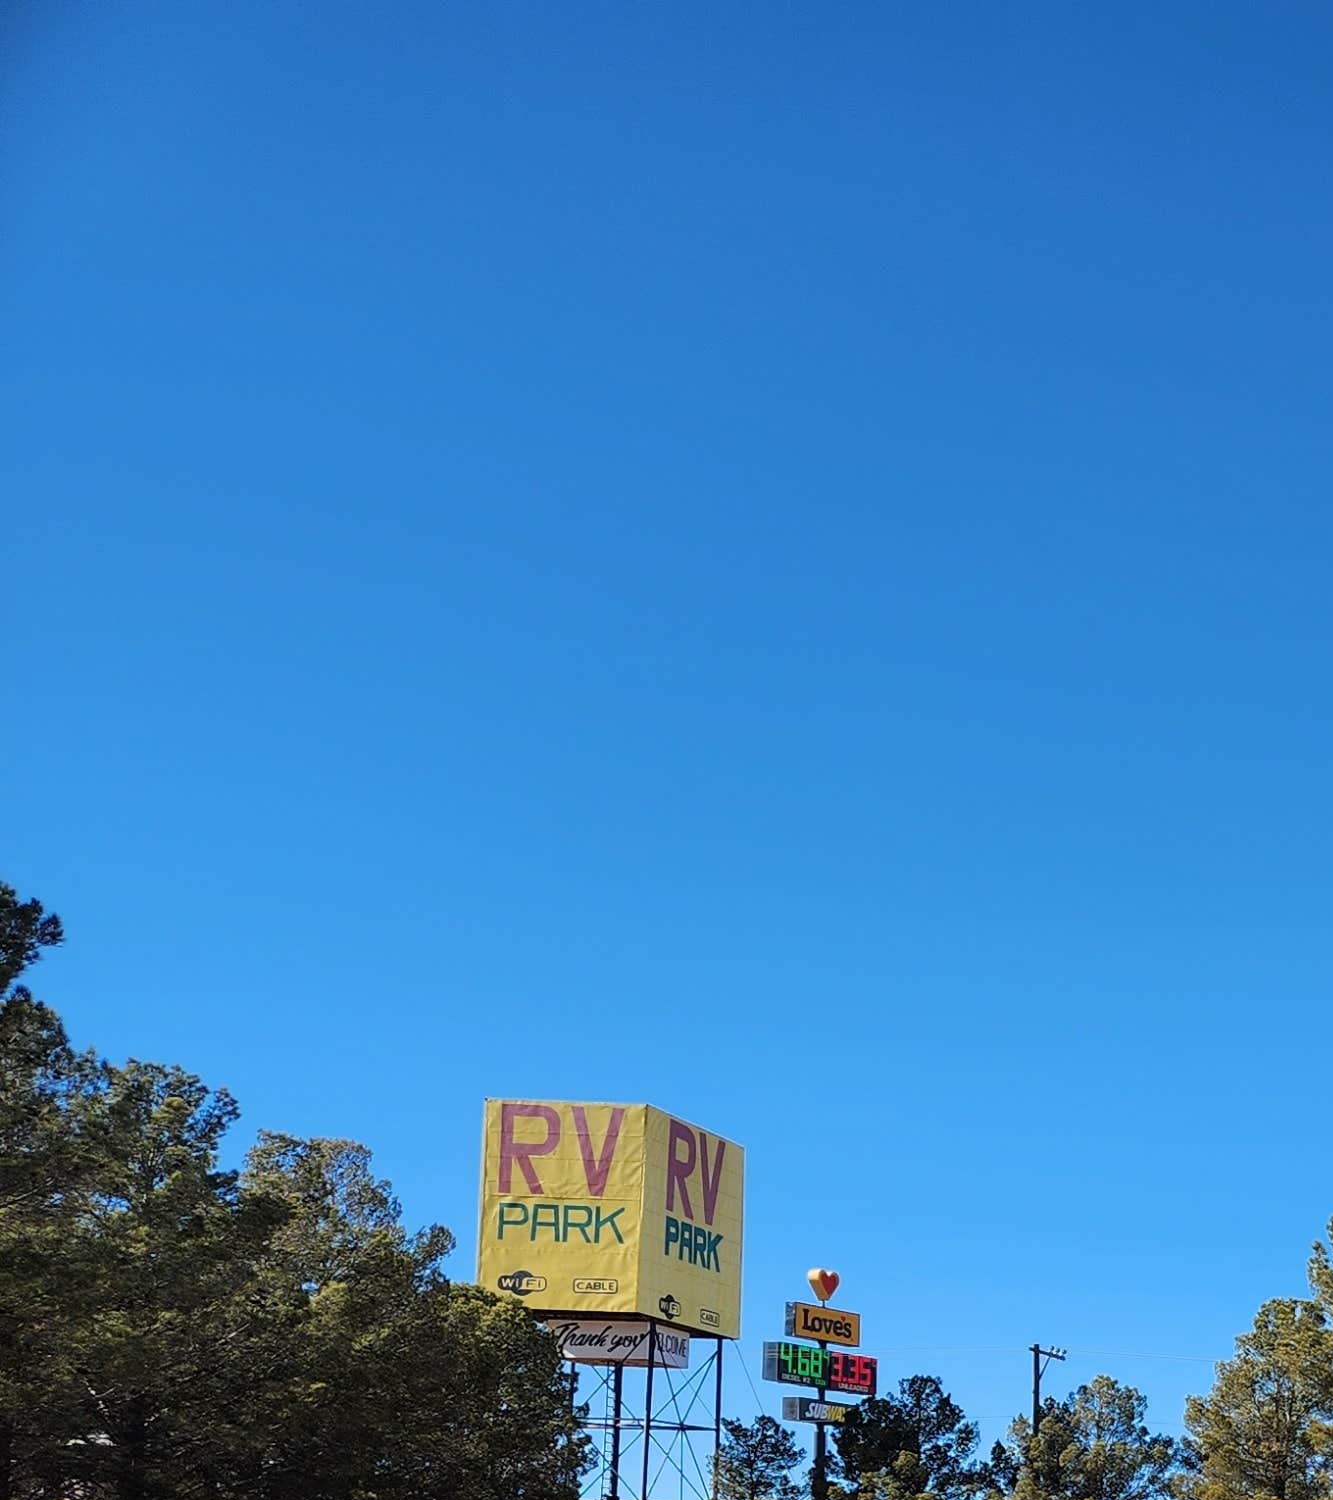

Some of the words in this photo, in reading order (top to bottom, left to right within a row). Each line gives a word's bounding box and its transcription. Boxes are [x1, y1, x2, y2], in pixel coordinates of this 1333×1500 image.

[497, 1103, 625, 1197] RV
[665, 1118, 726, 1226] RV
[497, 1202, 625, 1244] PARK
[664, 1215, 724, 1273] PARK
[575, 1280, 616, 1291] CABLE
[700, 1312, 719, 1325] CABLE
[555, 1322, 612, 1347] Thank
[611, 1333, 645, 1352] you
[655, 1332, 687, 1358] ELCOME
[838, 1383, 869, 1392] UNLEADED
[804, 1402, 847, 1422] SUBWA
